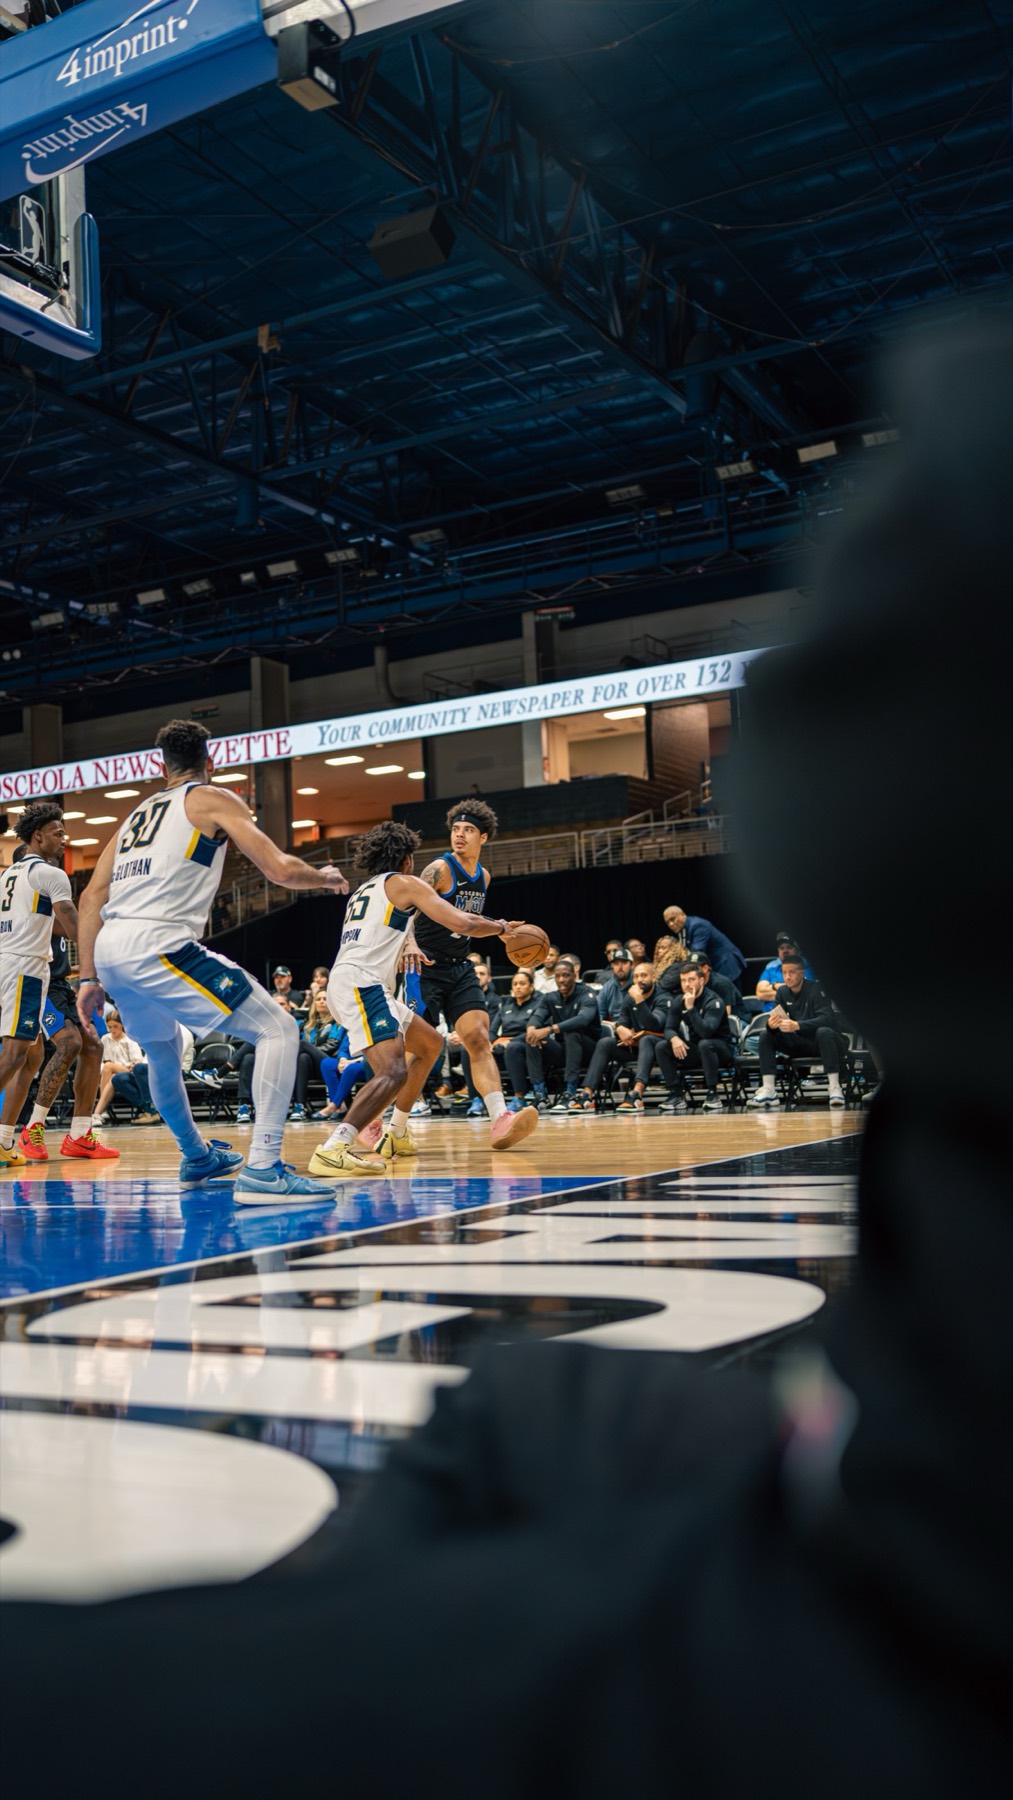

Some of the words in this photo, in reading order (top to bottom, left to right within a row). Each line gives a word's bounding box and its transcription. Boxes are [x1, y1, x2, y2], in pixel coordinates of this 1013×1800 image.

[317, 724, 361, 746] YOUR
[368, 706, 472, 738] COMMUNITY
[477, 690, 585, 722] NEWSPAPER
[592, 681, 629, 703] FOR
[636, 672, 686, 696] OVER
[695, 660, 732, 688] 132
[0, 765, 86, 799] SCEOLA
[119, 799, 172, 854] 30
[2, 875, 18, 912] 3
